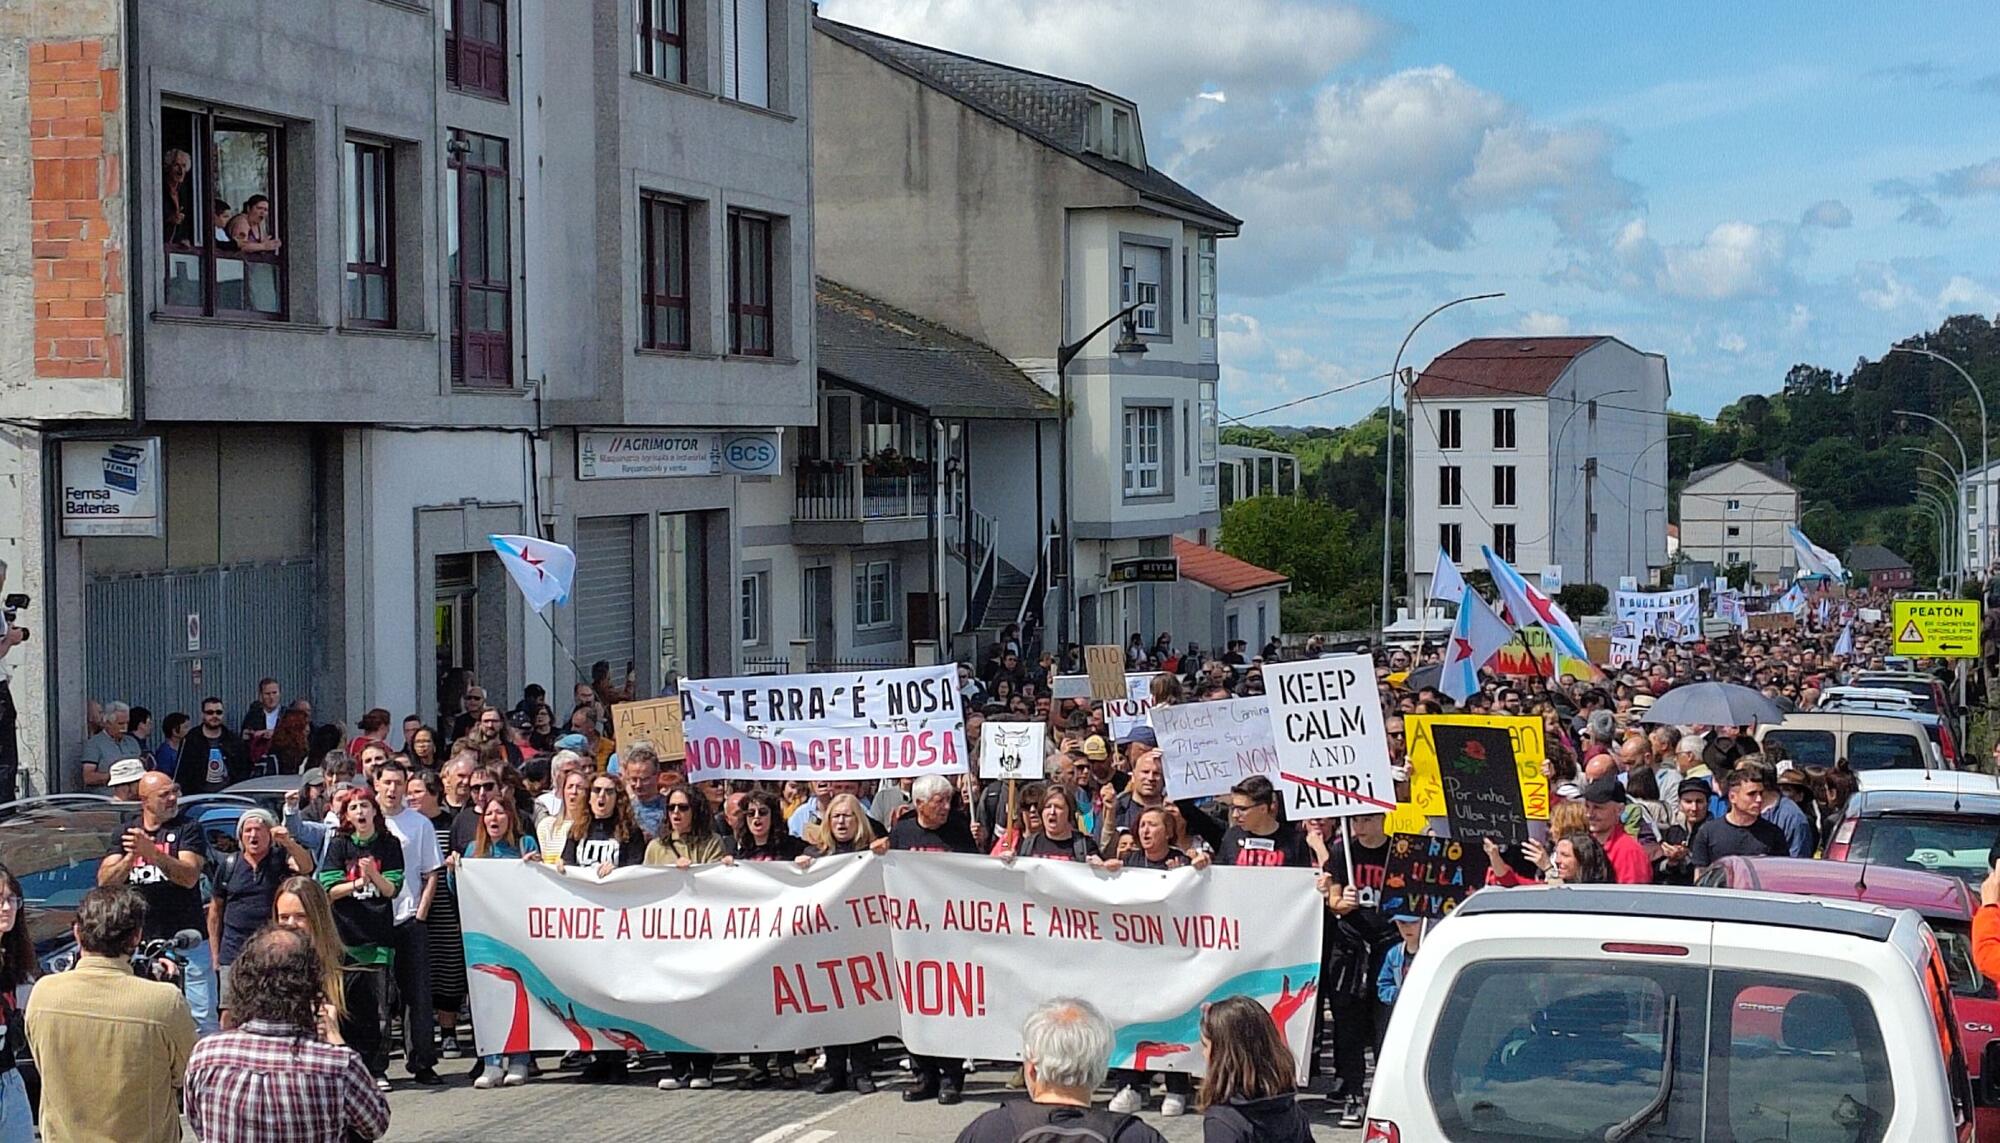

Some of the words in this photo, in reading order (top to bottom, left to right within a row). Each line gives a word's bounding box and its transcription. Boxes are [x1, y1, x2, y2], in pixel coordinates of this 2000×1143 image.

[623, 438, 699, 451] AGRIMOTOR
[731, 446, 770, 462] BCS
[65, 487, 110, 500] Femsa
[1909, 604, 1964, 617] PEATÓN
[1278, 669, 1356, 705] KEEP
[717, 687, 827, 722] TERRA
[887, 678, 955, 717] NOSA
[620, 703, 679, 728] ALTR
[1285, 705, 1367, 743] CALM
[684, 735, 742, 774] NON
[760, 740, 798, 772] DA
[808, 729, 959, 772] CELULOSA
[1308, 744, 1357, 769] AND
[1185, 758, 1232, 785] ALTRI
[1236, 744, 1281, 776] NON
[1444, 776, 1472, 800] Por
[1411, 862, 1464, 886] ULLA
[528, 906, 605, 940] DENDE
[616, 907, 632, 940] A
[641, 907, 713, 940] ULLOA
[723, 906, 761, 940] ATA
[769, 905, 783, 938] A
[943, 900, 1012, 936] AUGA
[1023, 903, 1036, 937] E
[1048, 906, 1103, 941] AIRE
[1112, 911, 1164, 946] SON
[1172, 914, 1241, 951] VIDA!
[770, 950, 893, 1017] ALTRI
[895, 959, 986, 1017] NON!
[1964, 1022, 1993, 1032] C4
